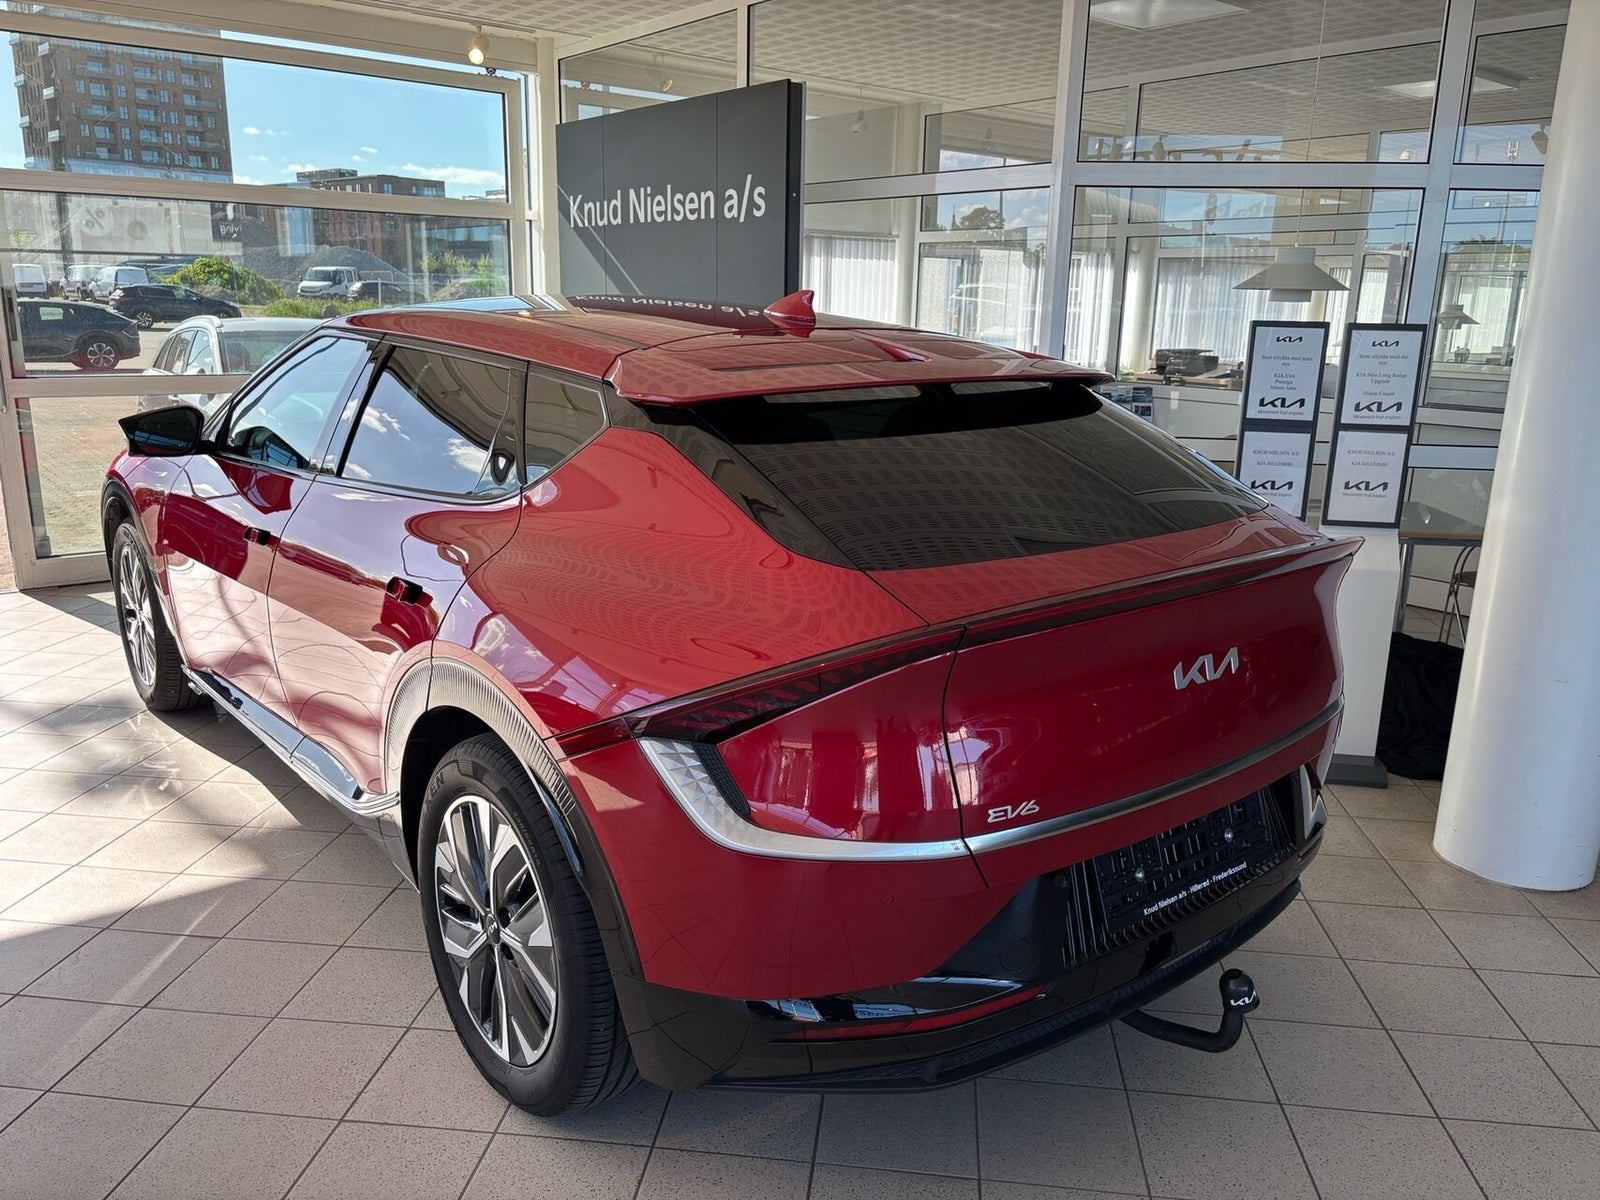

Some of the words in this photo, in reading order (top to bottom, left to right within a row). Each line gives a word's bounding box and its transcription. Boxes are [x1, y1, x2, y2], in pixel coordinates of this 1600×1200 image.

[569, 189, 622, 229] Knud
[628, 184, 715, 224] Nielsen
[723, 174, 766, 223] a/s
[1276, 335, 1304, 343] KIA
[1371, 340, 1400, 348] KIA
[1258, 396, 1306, 409] KIA
[1354, 401, 1403, 413] KIA
[1250, 479, 1294, 491] KIA
[1344, 480, 1389, 492] KIA
[1173, 647, 1239, 690] KIA
[987, 799, 1040, 823] EV6
[1143, 904, 1159, 916] Knud
[1158, 895, 1179, 909] Nielsen
[1178, 890, 1187, 899] a/s
[1212, 861, 1247, 882] Frederikssund
